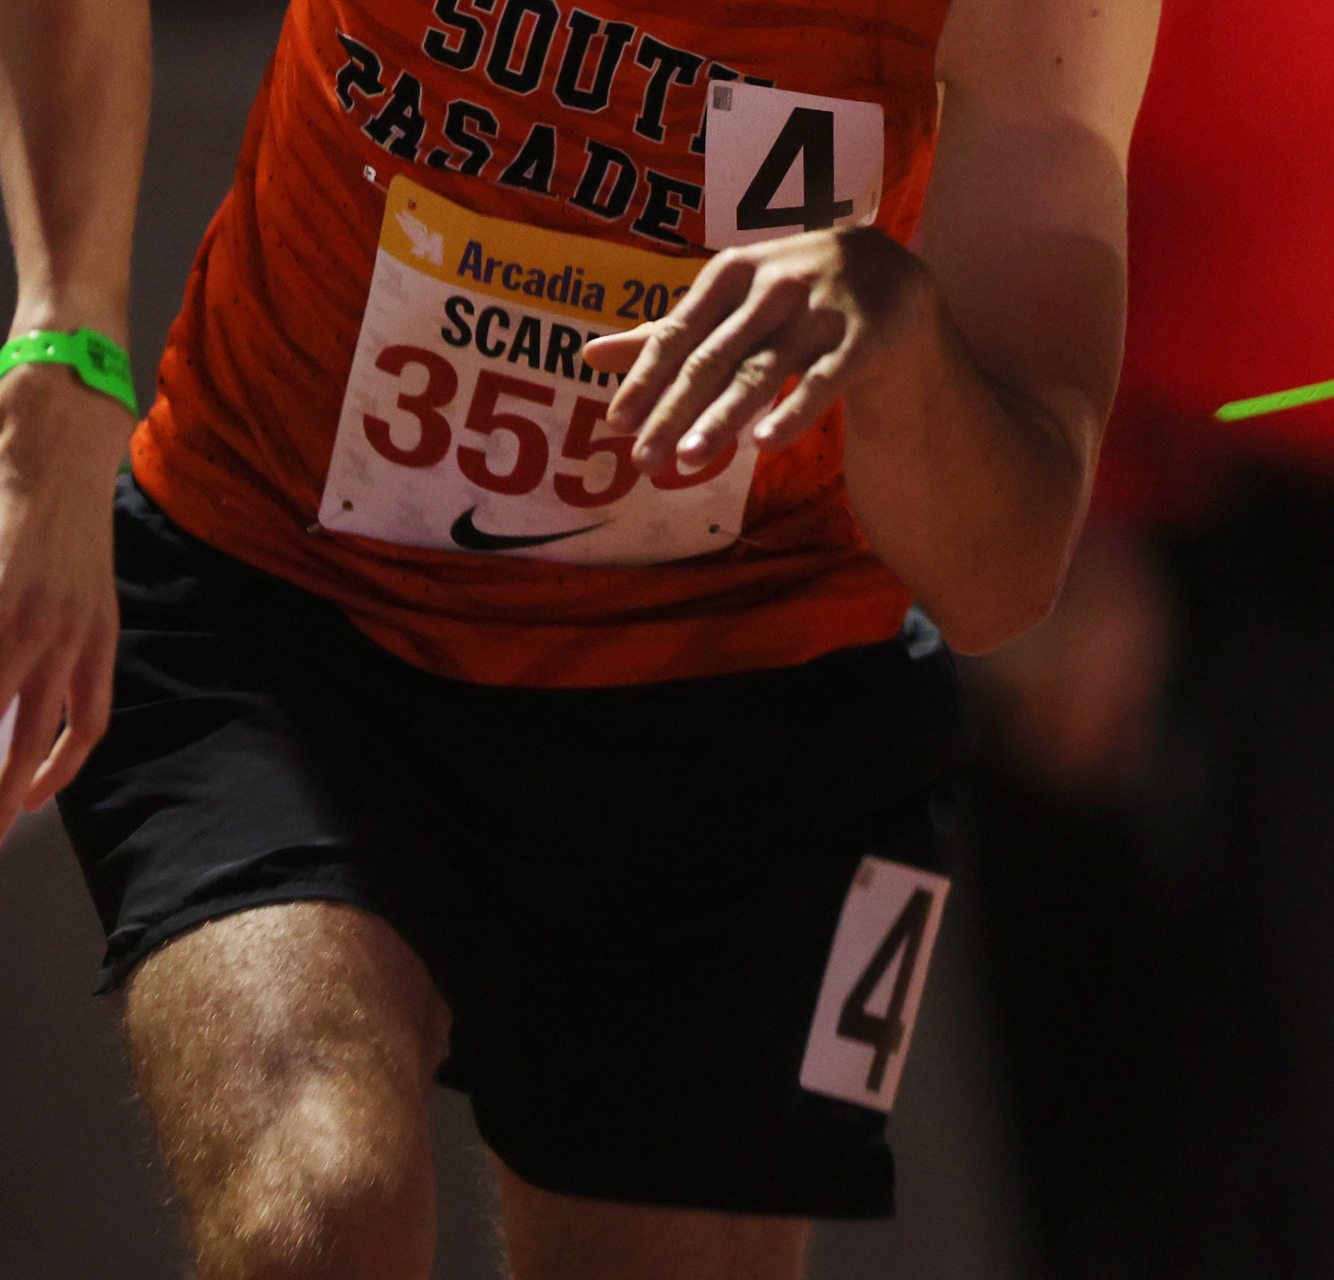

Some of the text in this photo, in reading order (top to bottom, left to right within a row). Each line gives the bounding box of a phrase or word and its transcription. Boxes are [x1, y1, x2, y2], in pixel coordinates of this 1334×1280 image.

[736, 106, 854, 233] 4
[456, 238, 606, 313] Arcadia
[835, 888, 934, 1094] 4
